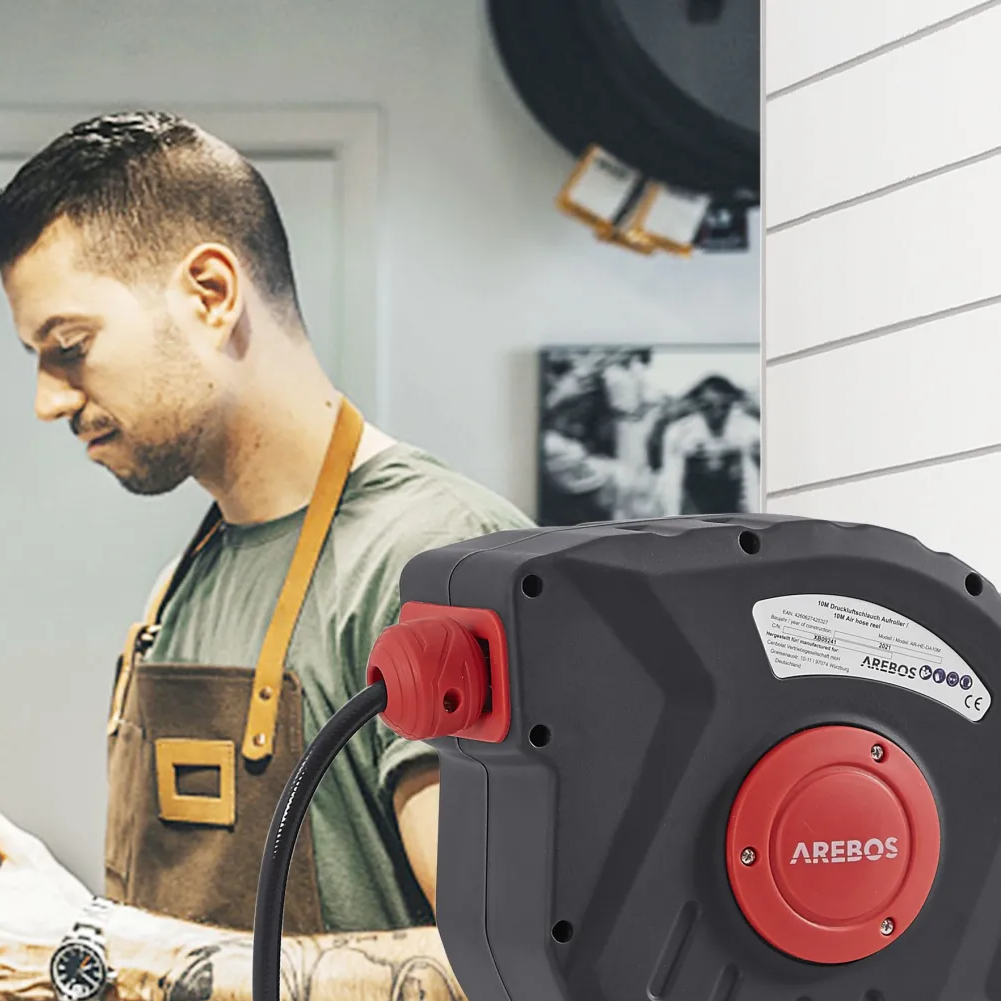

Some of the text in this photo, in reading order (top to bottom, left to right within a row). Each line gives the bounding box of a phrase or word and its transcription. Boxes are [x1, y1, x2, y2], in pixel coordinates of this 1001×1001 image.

[794, 612, 829, 625] 4260627425327
[818, 600, 829, 608] 10M
[830, 603, 880, 621] Druckluftschlauch
[881, 616, 906, 628] Aufroller
[855, 618, 869, 627] hose
[879, 642, 892, 650] 2021
[860, 656, 917, 679] AREBOS
[789, 837, 899, 864] AREBOS
